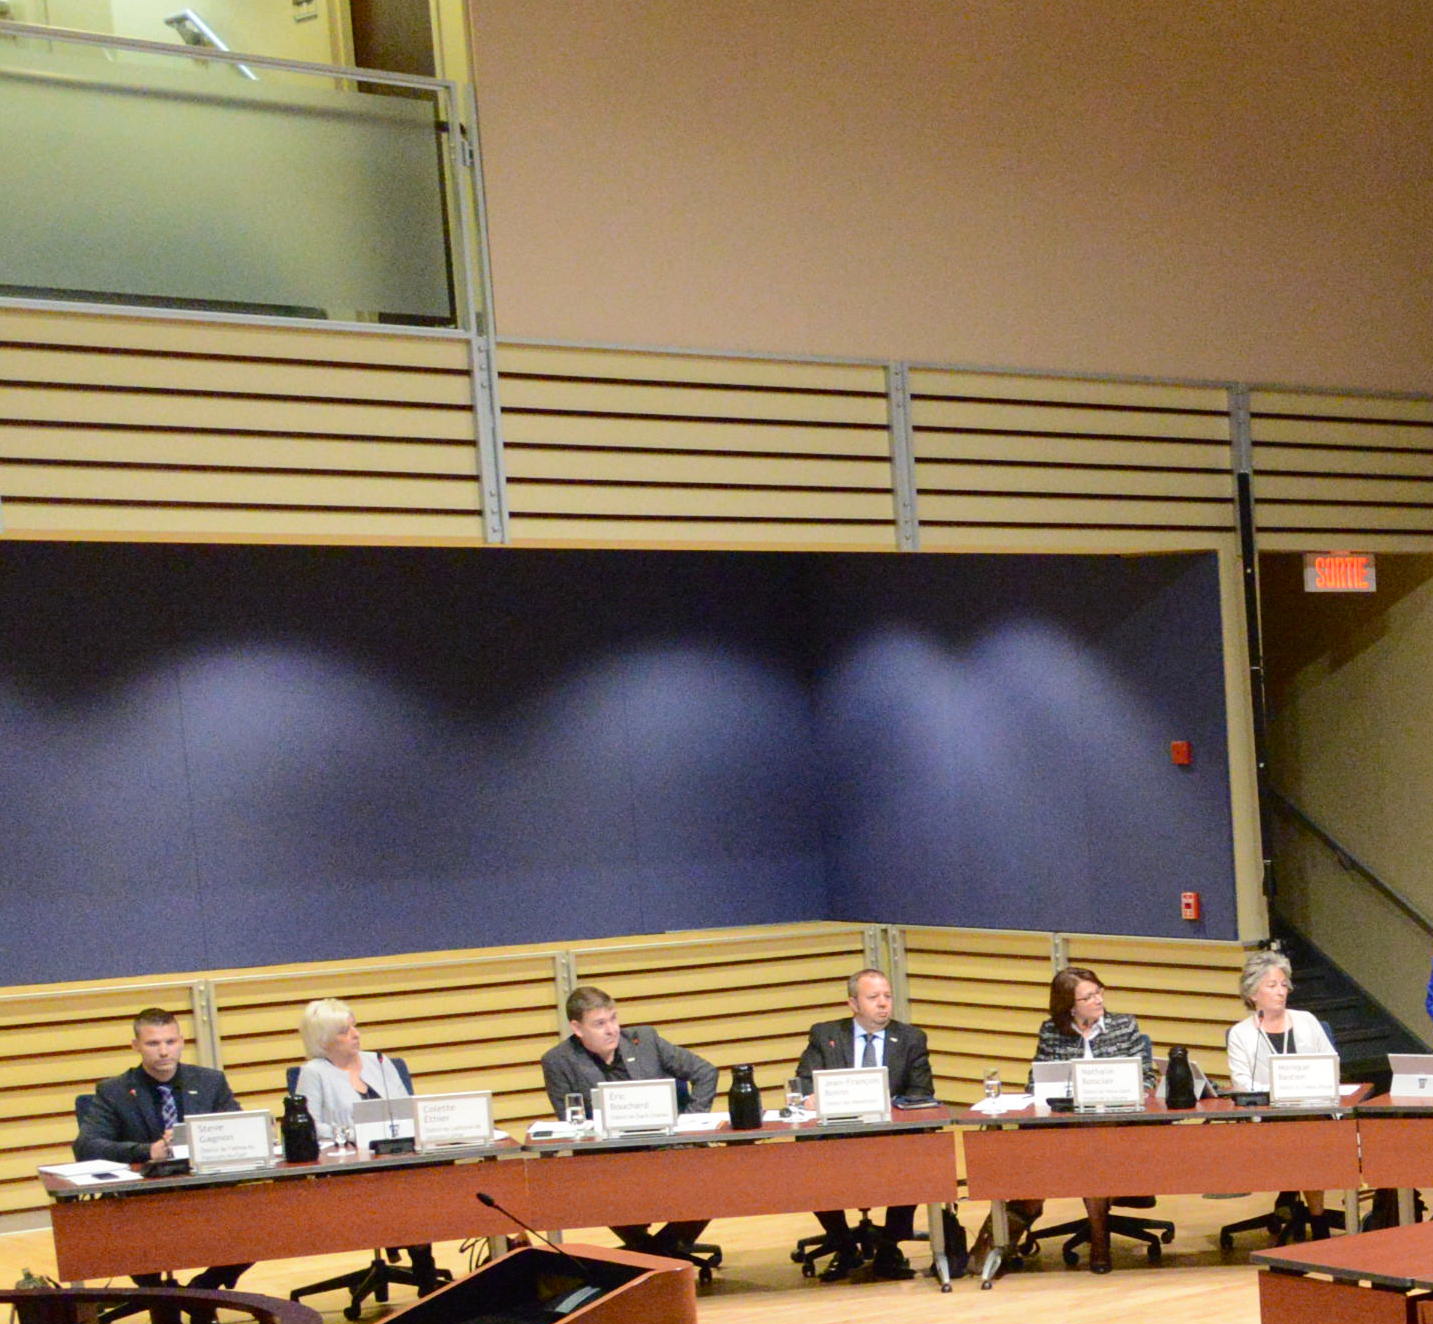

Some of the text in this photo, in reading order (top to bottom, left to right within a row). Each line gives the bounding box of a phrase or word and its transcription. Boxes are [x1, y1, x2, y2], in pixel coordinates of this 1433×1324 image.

[1315, 556, 1369, 589] SORTIE
[197, 1125, 224, 1133] Steve
[199, 1135, 234, 1144] Gagnon
